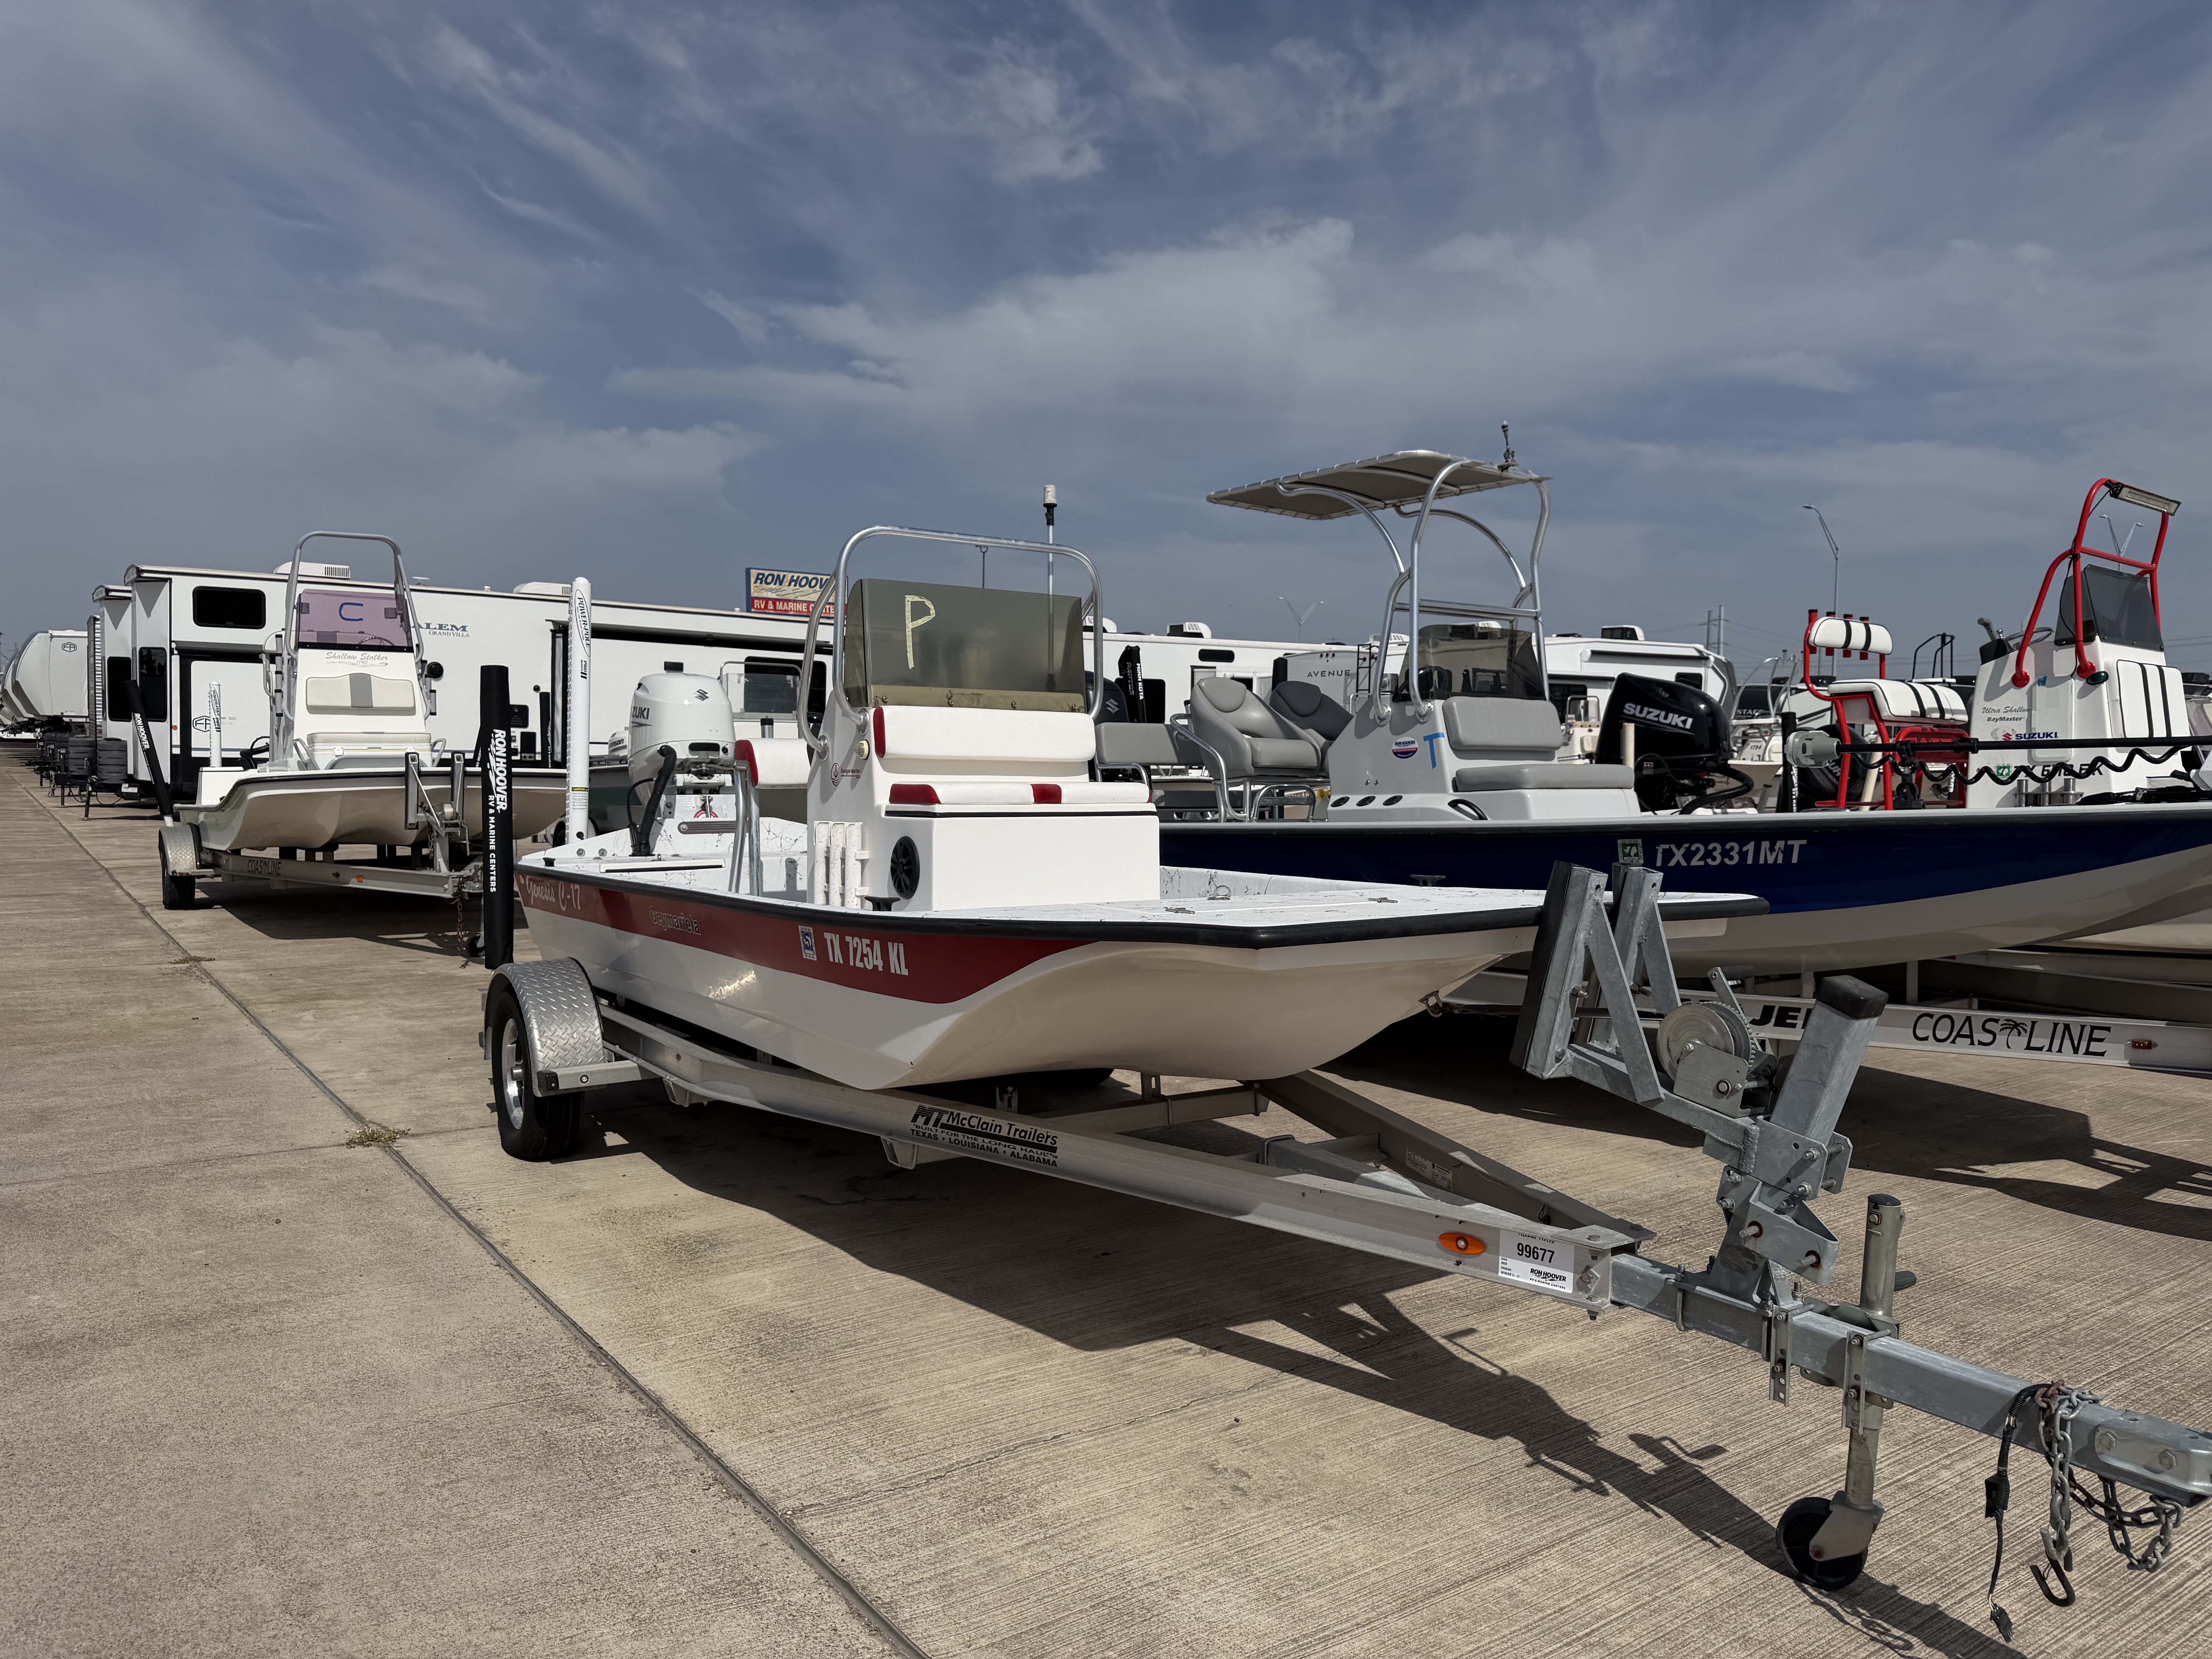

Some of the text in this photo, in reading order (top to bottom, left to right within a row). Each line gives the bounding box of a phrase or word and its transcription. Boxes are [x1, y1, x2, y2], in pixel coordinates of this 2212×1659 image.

[754, 572, 828, 589] RON HOOV
[339, 602, 364, 622] C
[754, 600, 765, 609] RV
[776, 601, 807, 611] MARINE
[905, 595, 936, 669] P
[632, 706, 650, 720] ZUKI
[1623, 703, 1693, 729] SUZUKI
[1423, 732, 1445, 769] T
[493, 729, 507, 811] RON HOOVER
[488, 795, 495, 807] RV
[1656, 840, 1807, 867] TX2331MT
[824, 932, 843, 964] TX
[845, 936, 883, 971] 7254
[888, 941, 908, 975] KL
[946, 1111, 1002, 1134] McClain
[1007, 1122, 1058, 1145] Trailers
[910, 1128, 1058, 1167] TEXAS LOUISIANA ALABAMA
[982, 1139, 1017, 1150] LONG
[1517, 1242, 1555, 1263] 99677
[1530, 1268, 1542, 1277] RON
[1543, 1271, 1566, 1281] HOOVER
